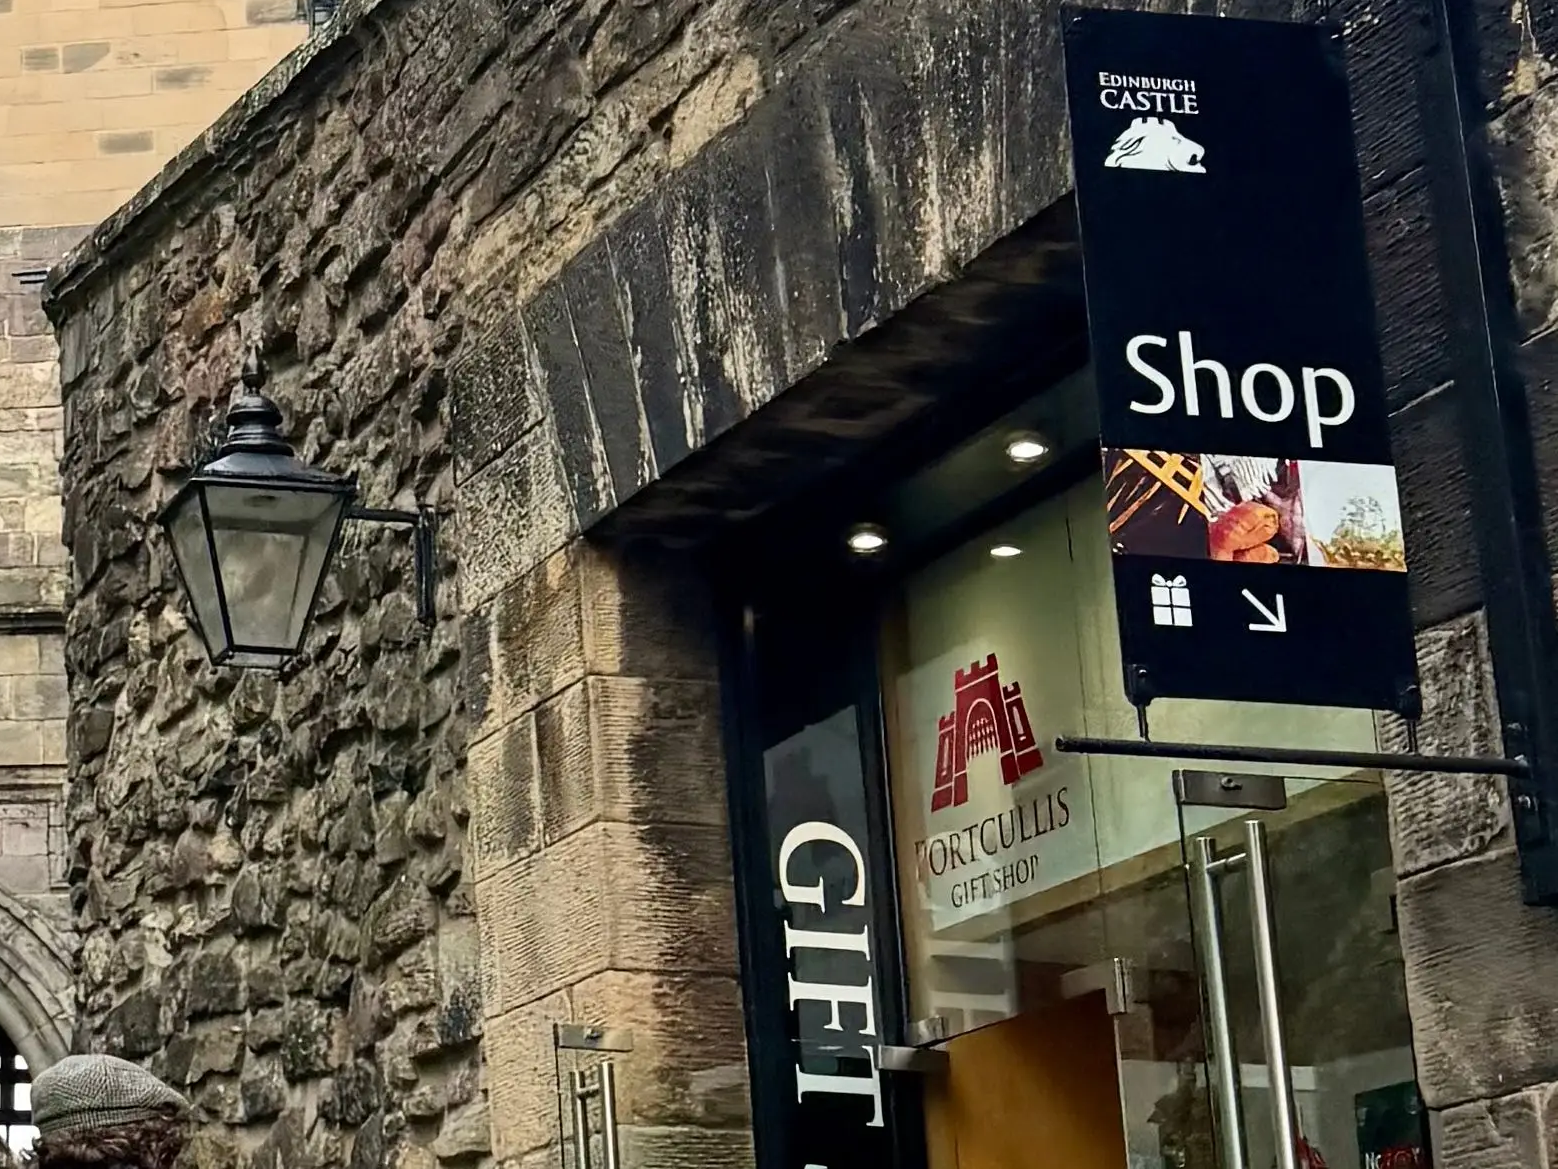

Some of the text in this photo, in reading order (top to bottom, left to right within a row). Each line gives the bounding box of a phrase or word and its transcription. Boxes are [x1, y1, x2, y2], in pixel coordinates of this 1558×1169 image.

[1098, 71, 1196, 92] EDINBURGH
[1099, 89, 1199, 114] CASTLE
[1125, 330, 1356, 448] Shop
[950, 854, 1039, 908] GIFT SHOP
[778, 820, 885, 1127] GIFT
